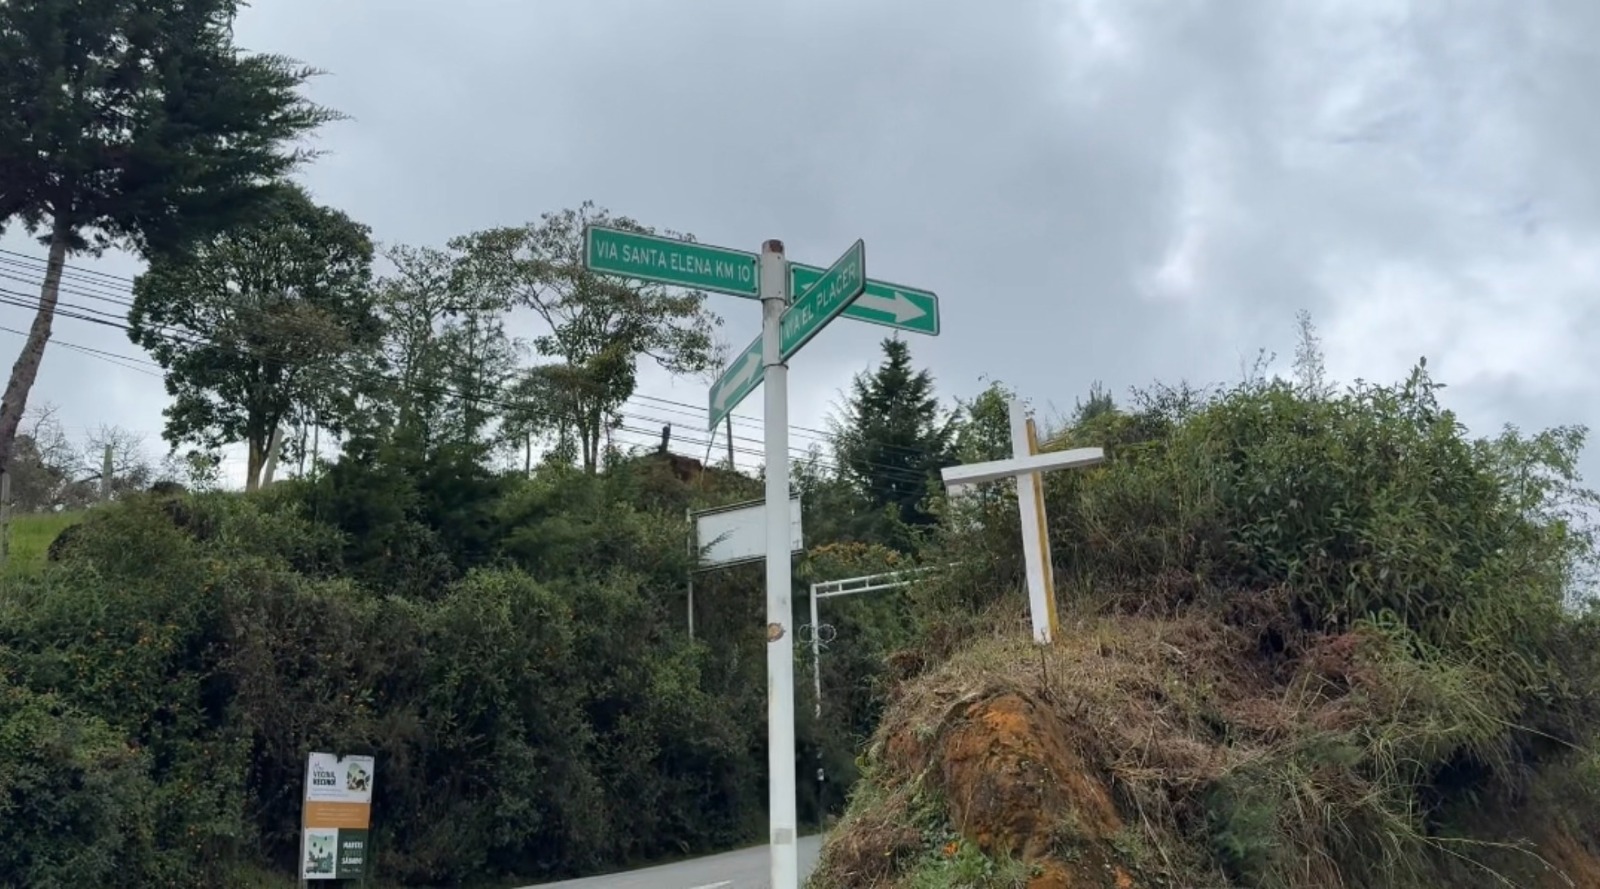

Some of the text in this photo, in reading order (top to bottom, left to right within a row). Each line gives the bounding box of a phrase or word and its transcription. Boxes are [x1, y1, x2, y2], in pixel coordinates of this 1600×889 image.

[595, 239, 750, 282] VIA SANTA ELENA KM 10
[783, 262, 857, 341] VIA EL PLACER
